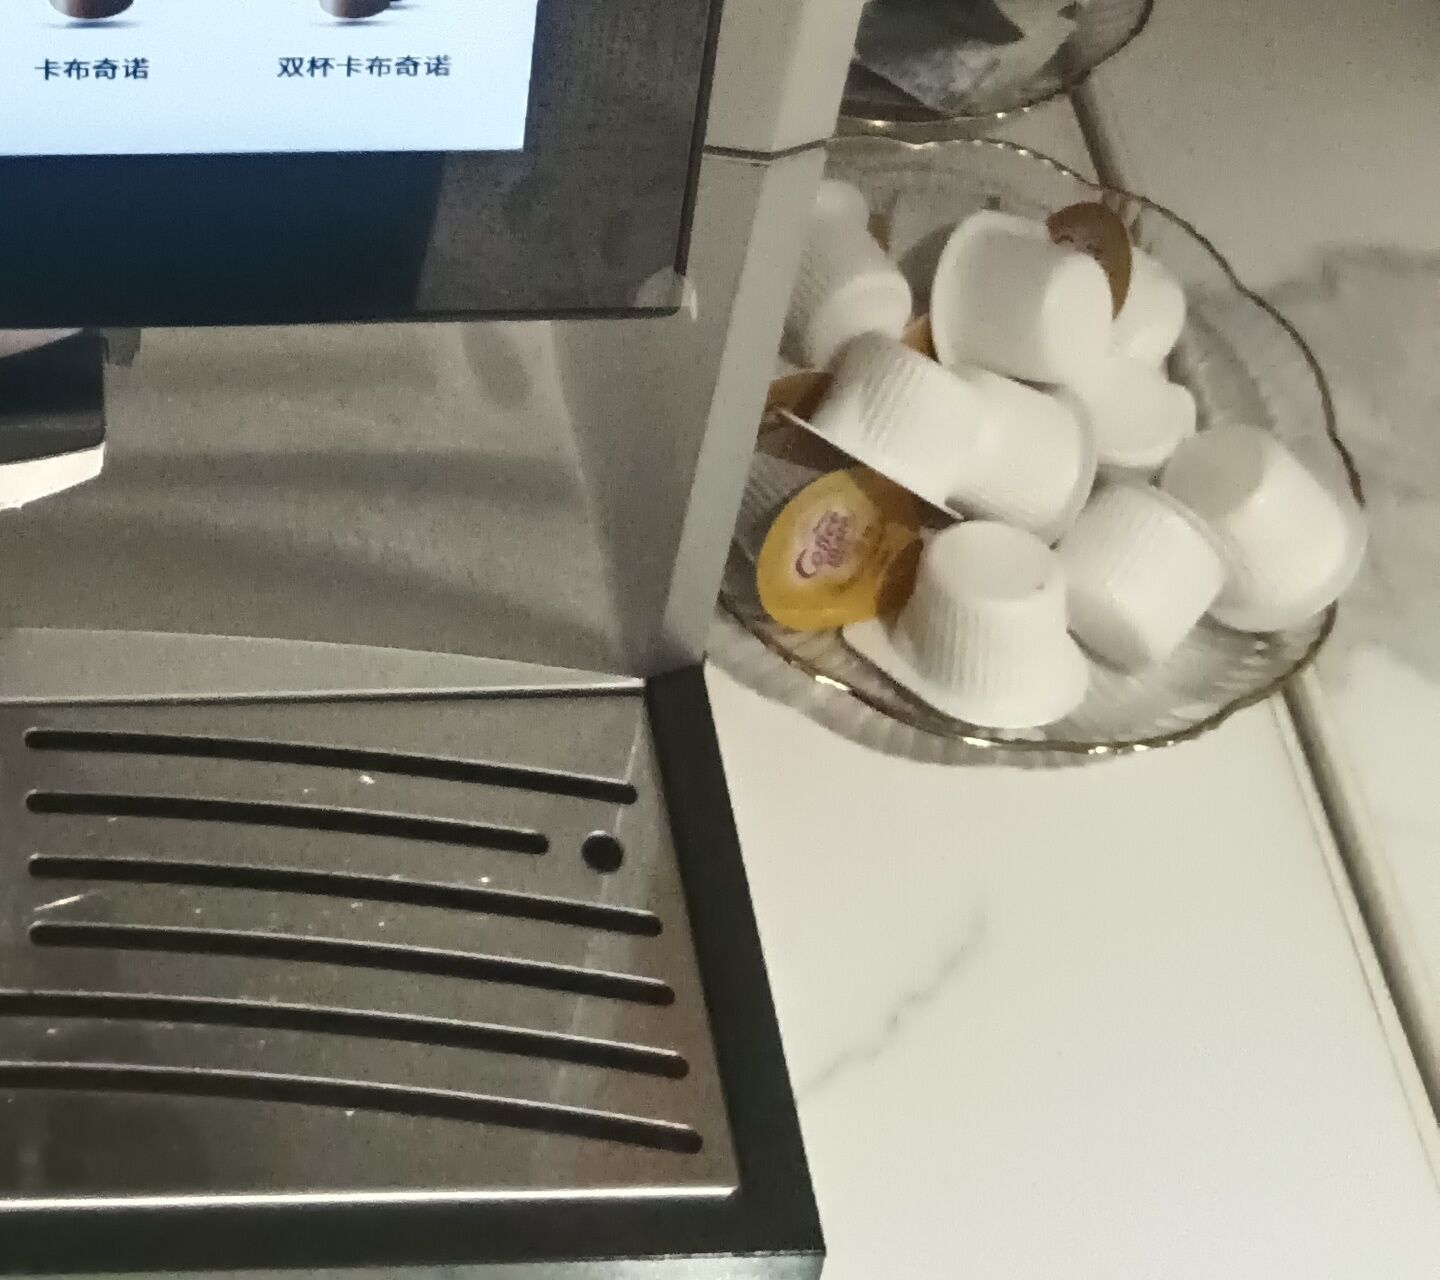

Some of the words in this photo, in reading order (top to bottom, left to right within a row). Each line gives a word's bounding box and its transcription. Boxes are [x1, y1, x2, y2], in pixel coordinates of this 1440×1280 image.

[35, 57, 149, 81] 卡布奇诺
[276, 54, 450, 78] 双杯卡布奇诺
